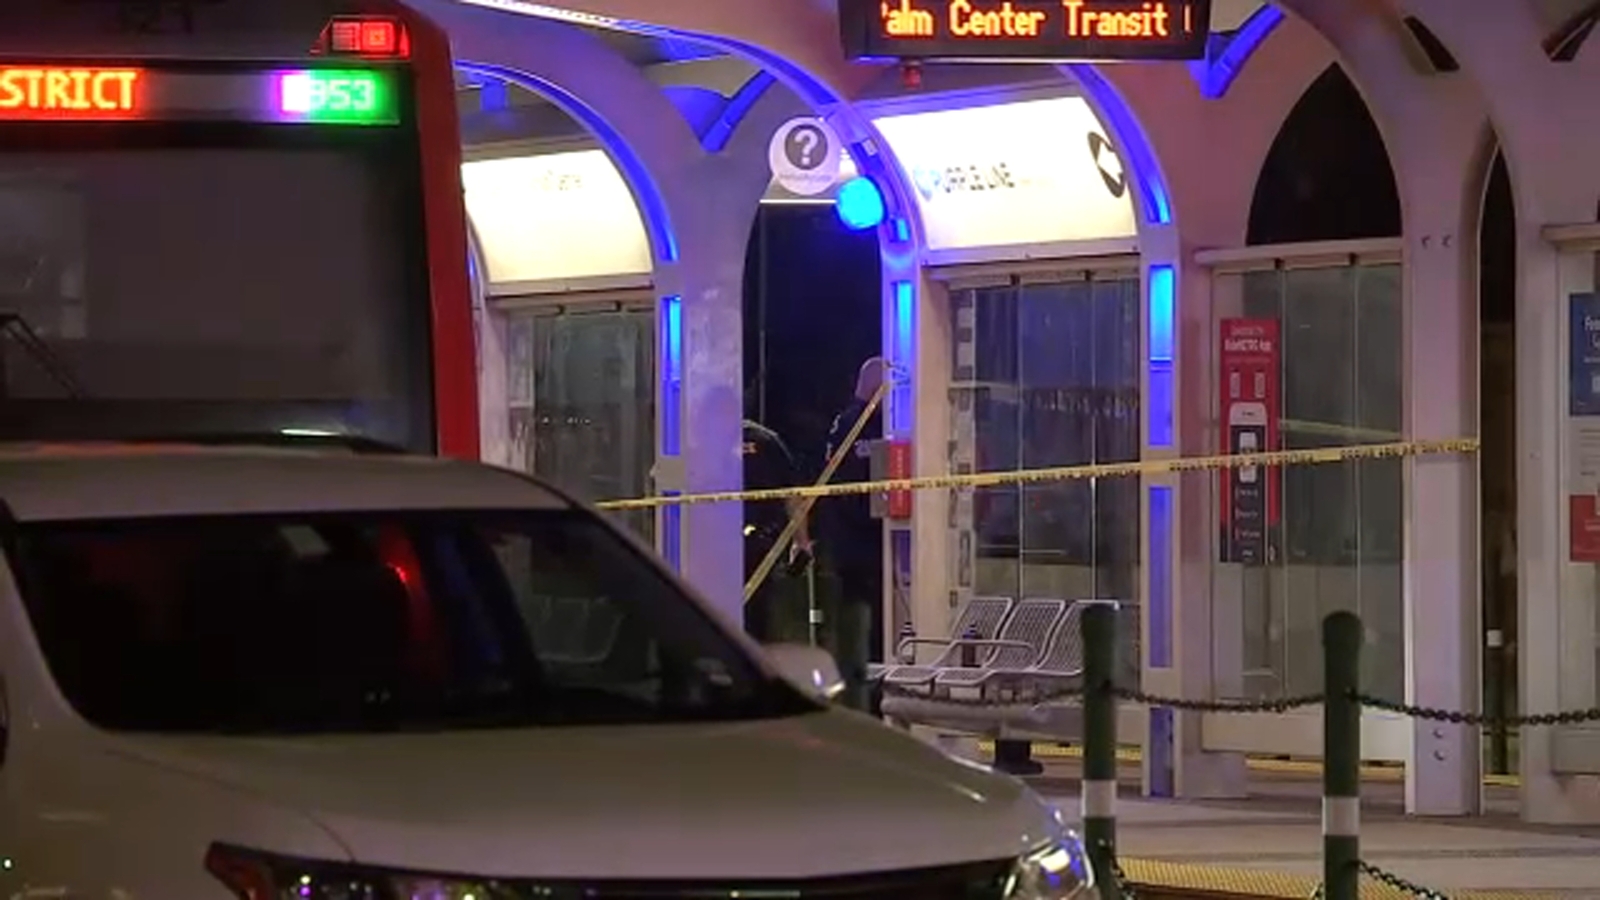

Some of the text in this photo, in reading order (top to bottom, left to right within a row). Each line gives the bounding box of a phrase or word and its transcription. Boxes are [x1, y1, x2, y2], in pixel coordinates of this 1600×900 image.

[881, 3, 934, 36] alm
[950, 0, 1045, 36] Center
[1063, 0, 1169, 36] Transit
[0, 70, 137, 110] STRICT
